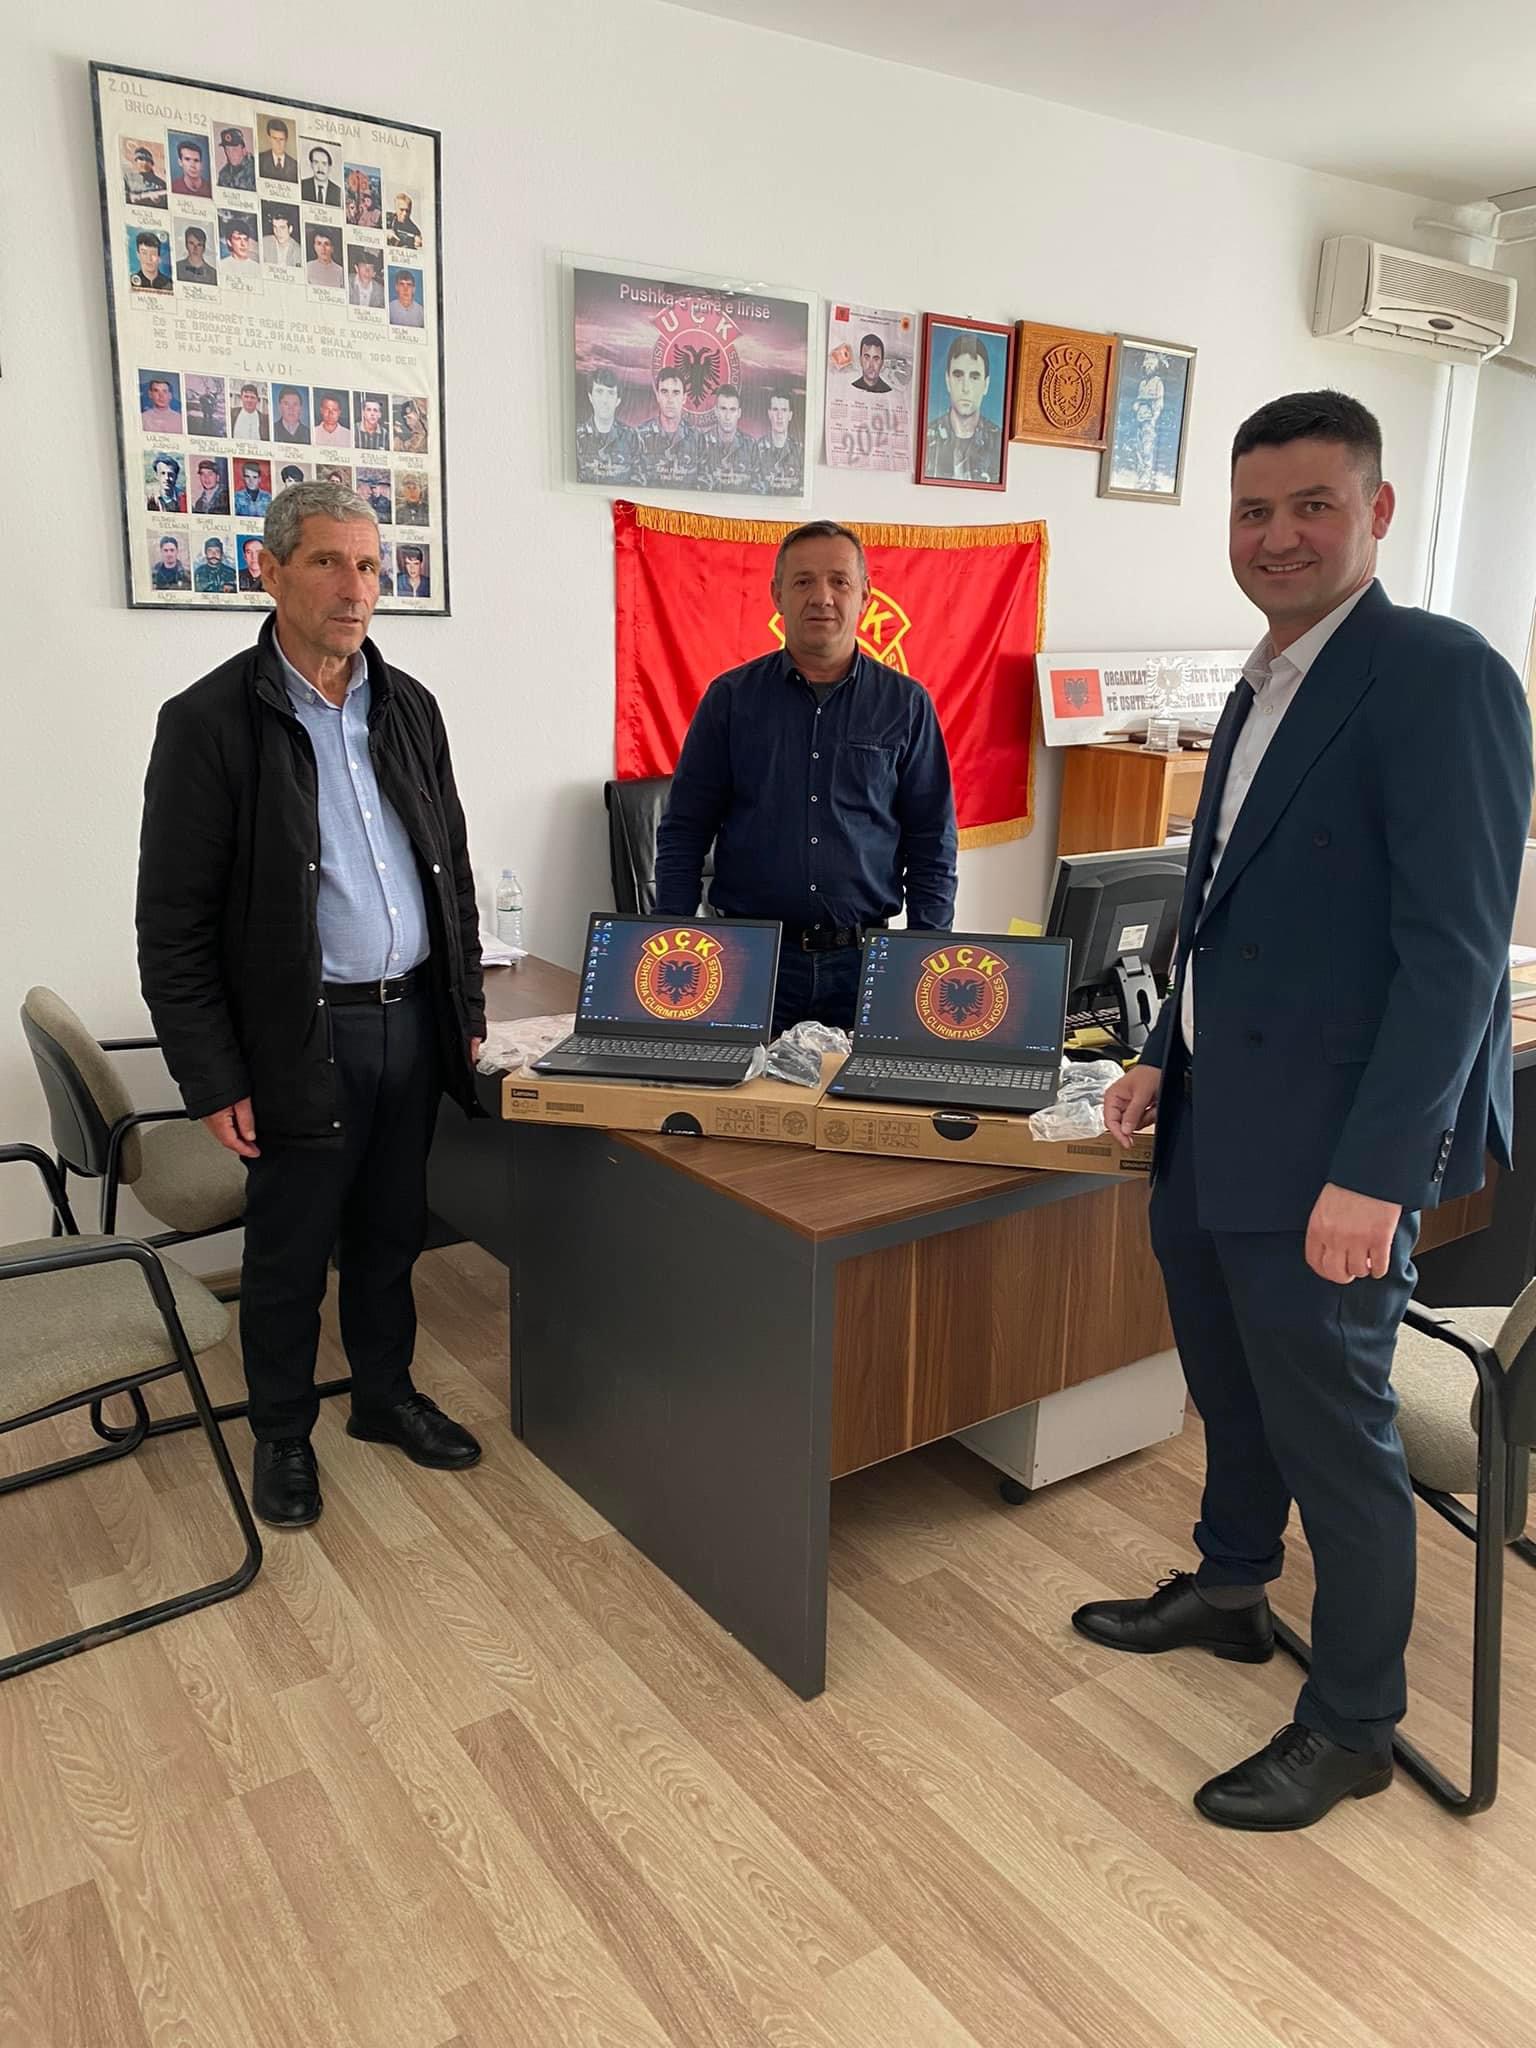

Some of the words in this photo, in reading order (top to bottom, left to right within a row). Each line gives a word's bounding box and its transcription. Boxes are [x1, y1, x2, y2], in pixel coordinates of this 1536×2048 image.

[619, 283, 674, 306] Pushka
[725, 303, 733, 314] e
[737, 302, 770, 319] lirisë
[1104, 669, 1147, 686] ORGANIZAT
[1107, 691, 1118, 711] TË
[648, 931, 716, 958] UÇK
[928, 948, 1000, 976] UÇK
[640, 957, 654, 997] USHTRIA
[698, 1000, 706, 1010] E
[920, 975, 935, 1016] USHTRIA
[983, 1022, 991, 1030] E
